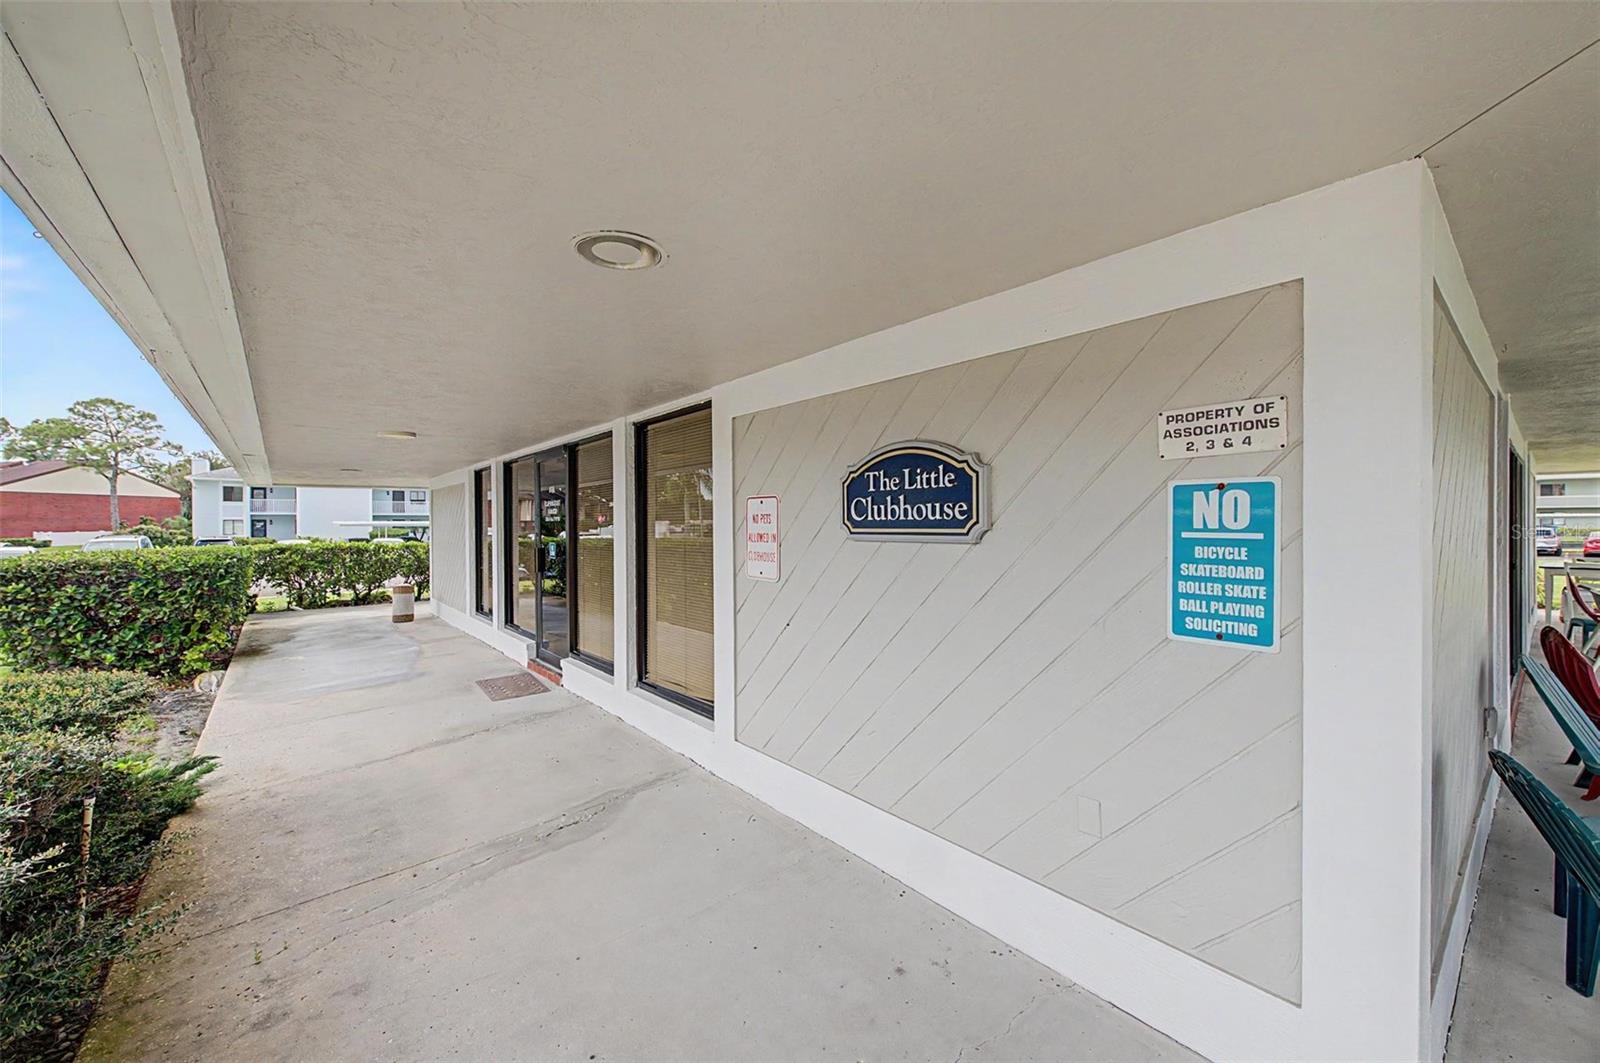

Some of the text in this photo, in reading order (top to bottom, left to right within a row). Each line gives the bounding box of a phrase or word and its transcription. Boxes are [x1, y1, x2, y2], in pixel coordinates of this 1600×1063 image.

[1166, 402, 1275, 425] PROPERTY OF
[1163, 417, 1280, 440] ASSOCIATIONS
[1186, 436, 1252, 453] 2, 3 & 4
[864, 464, 956, 492] The Little
[850, 494, 968, 521] Clubhouse
[1192, 489, 1251, 530] NO
[1194, 546, 1248, 560] BICYCLE
[1180, 563, 1265, 580] SKATEBOARD
[1178, 580, 1267, 600] ROLLER SKATE
[1179, 598, 1265, 619] BALL PLAYING
[1184, 616, 1259, 637] SOLICITING
